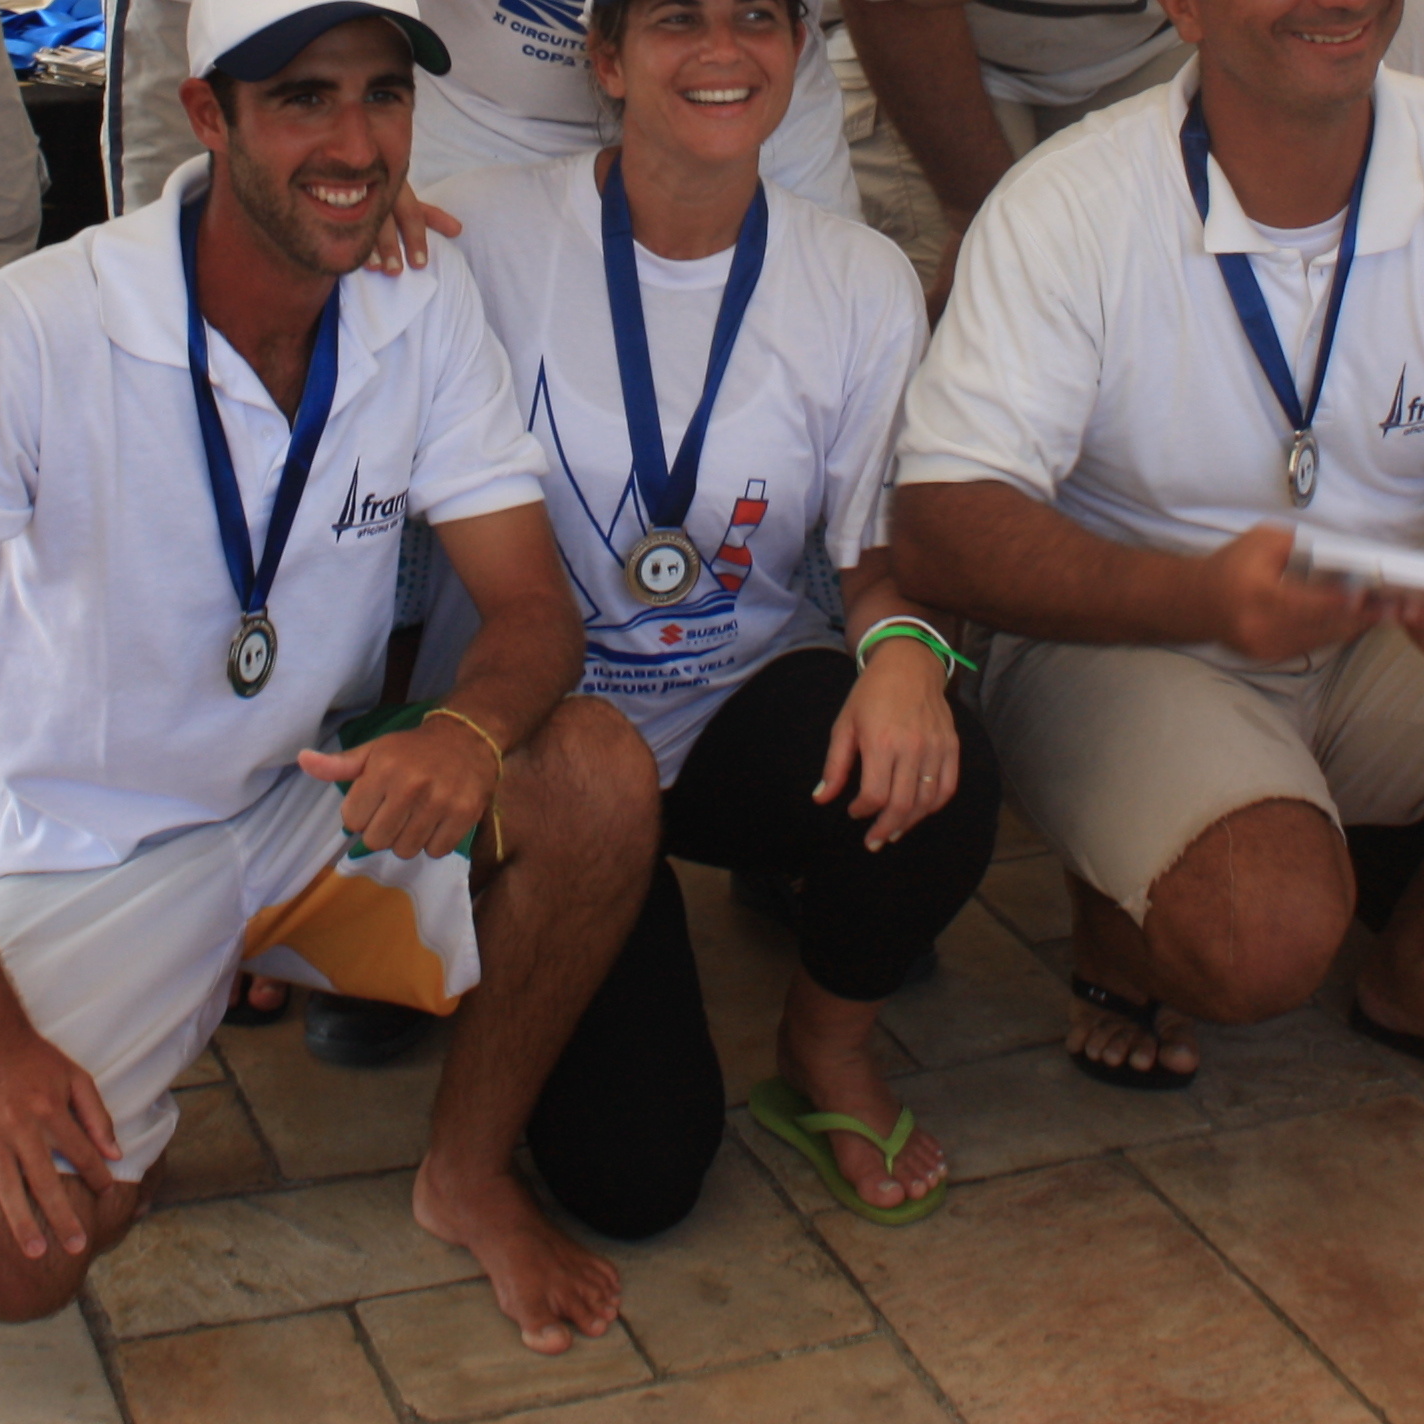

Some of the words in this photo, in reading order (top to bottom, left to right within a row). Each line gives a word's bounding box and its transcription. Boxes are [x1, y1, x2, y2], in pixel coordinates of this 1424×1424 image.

[493, 11, 507, 25] XI
[521, 43, 577, 67] COPA
[686, 619, 739, 639] SUZUKI
[593, 666, 681, 679] ILHABELA
[698, 656, 735, 673] VELA
[582, 681, 657, 694] SUZUKI
